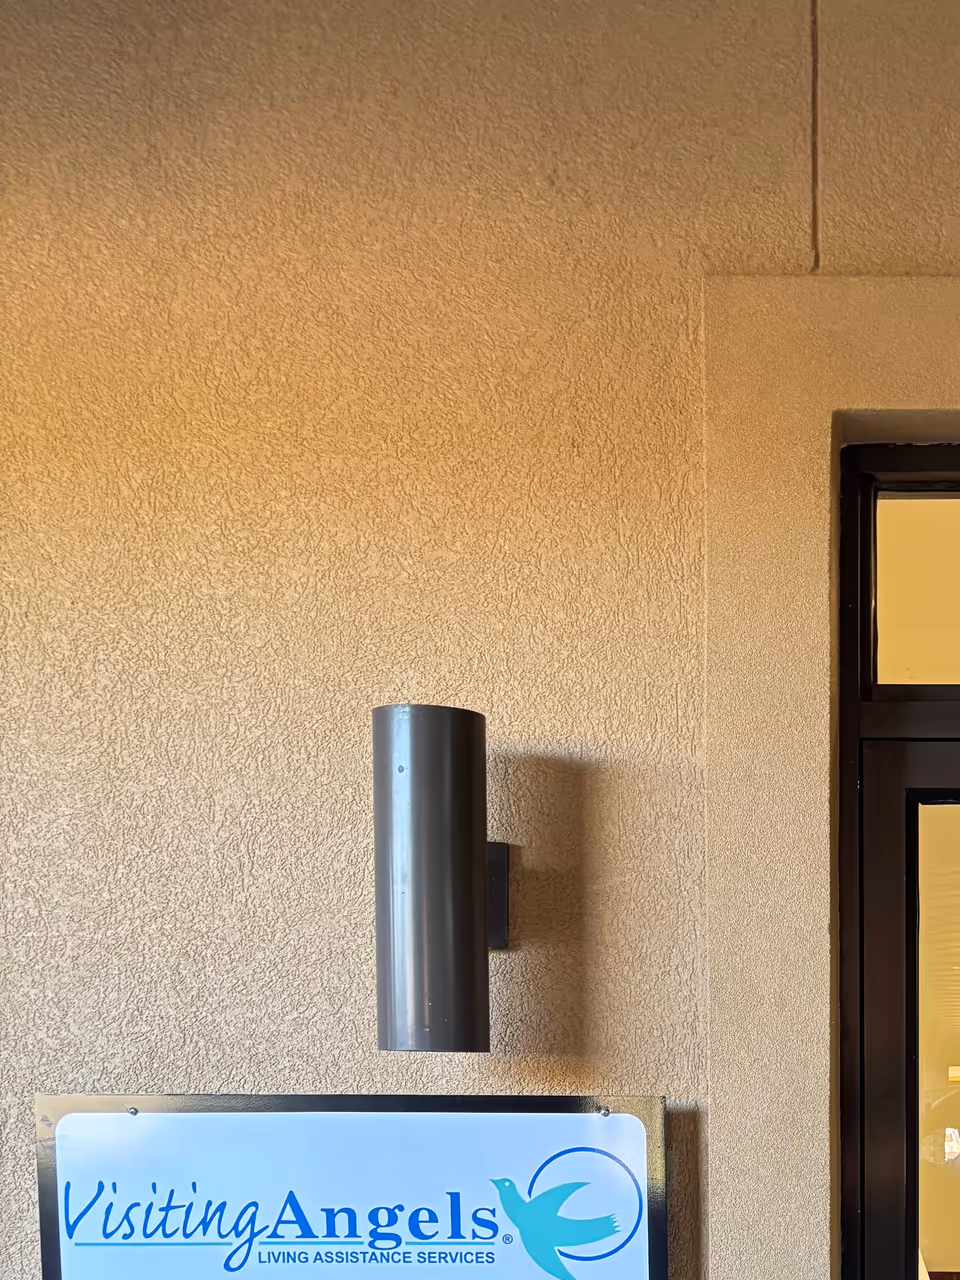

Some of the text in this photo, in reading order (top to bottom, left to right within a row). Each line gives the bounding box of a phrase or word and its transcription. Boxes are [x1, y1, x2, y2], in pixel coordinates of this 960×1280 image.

[258, 1251, 495, 1264] LIVING ASSISTANCE SERVICES
